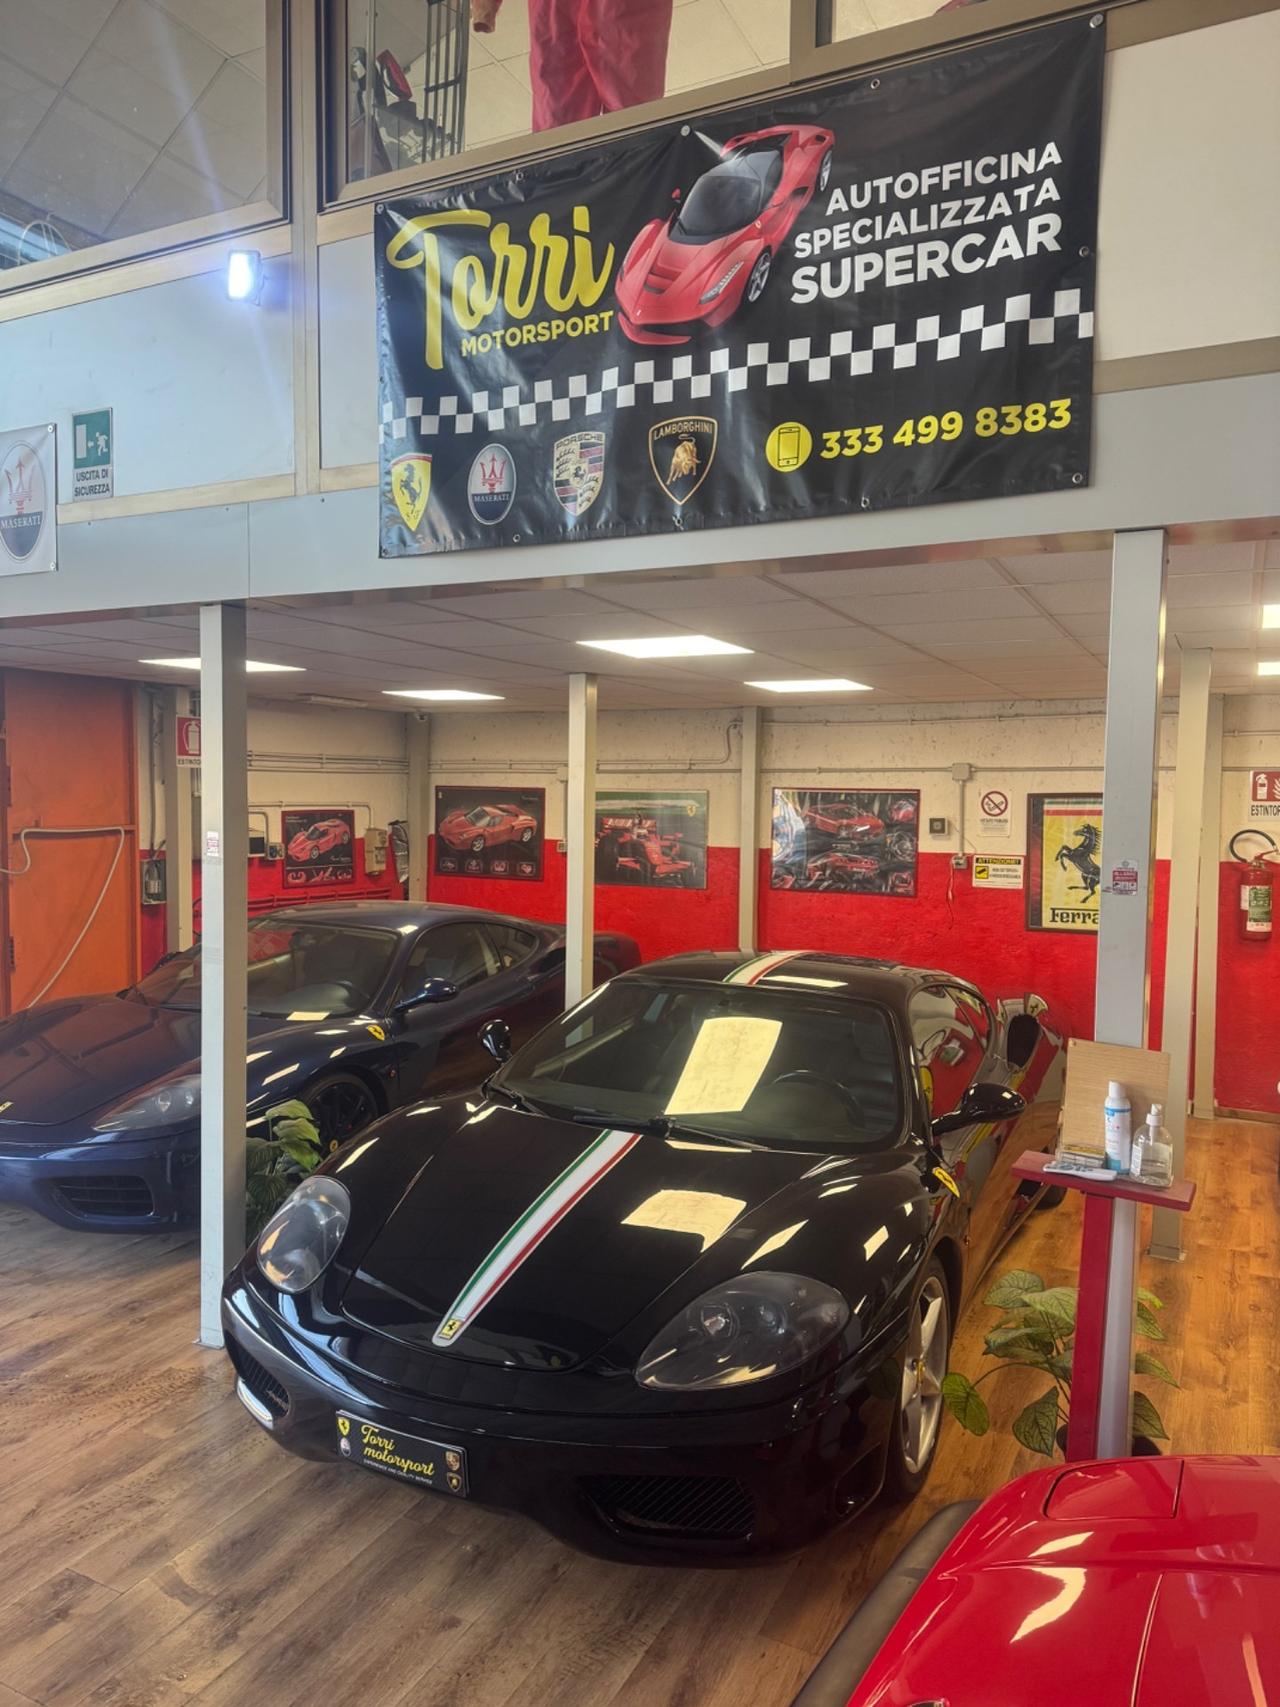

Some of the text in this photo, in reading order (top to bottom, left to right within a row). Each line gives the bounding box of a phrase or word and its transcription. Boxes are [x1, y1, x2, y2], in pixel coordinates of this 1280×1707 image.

[825, 141, 1062, 216] AUTOFFICINA
[794, 178, 1061, 258] SPECIALIZZATA
[790, 213, 1062, 304] SUPERCAR
[386, 205, 615, 370] Torri
[461, 310, 614, 357] MOTORSPORT
[653, 420, 713, 440] LAMBORGHINI
[820, 398, 1072, 459] 333 499 8383
[555, 433, 603, 449] PORSCHE
[76, 468, 109, 482] USCITA DI
[74, 483, 110, 497] SICUREZZA
[474, 493, 510, 503] MASERATI
[1, 516, 41, 529] MASERATI
[178, 758, 201, 766] ESTINTO
[1251, 804, 1280, 816] ESTINTOR
[1050, 908, 1099, 924] Ferra
[361, 1425, 395, 1450] Torri
[363, 1448, 435, 1475] motorsport
